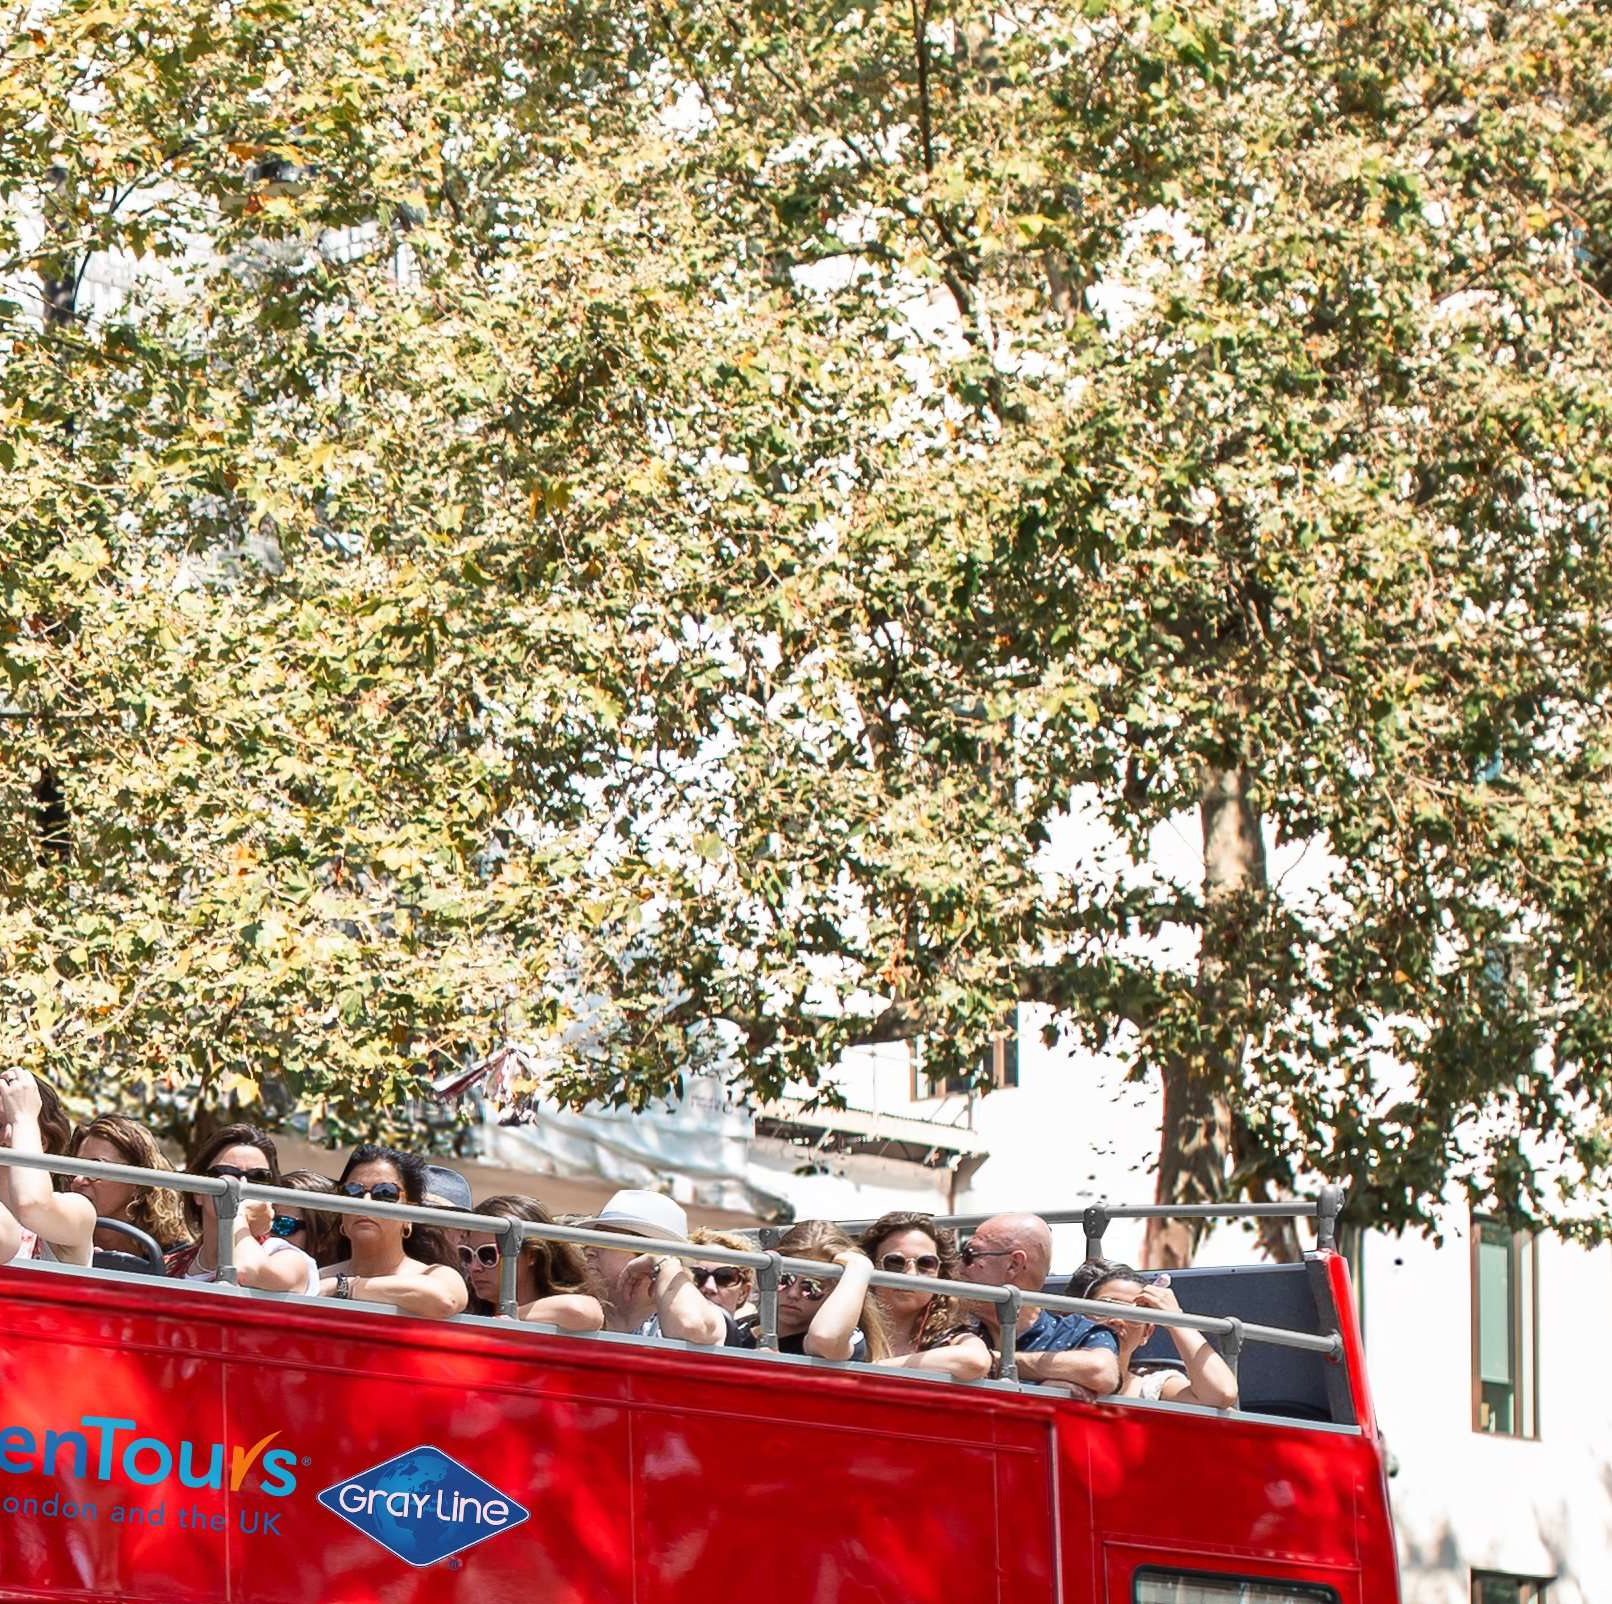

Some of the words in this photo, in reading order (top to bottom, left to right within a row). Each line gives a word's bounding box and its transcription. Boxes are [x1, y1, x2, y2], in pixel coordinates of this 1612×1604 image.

[111, 1503, 165, 1527] and
[178, 1504, 226, 1532] the
[239, 1509, 282, 1537] UK
